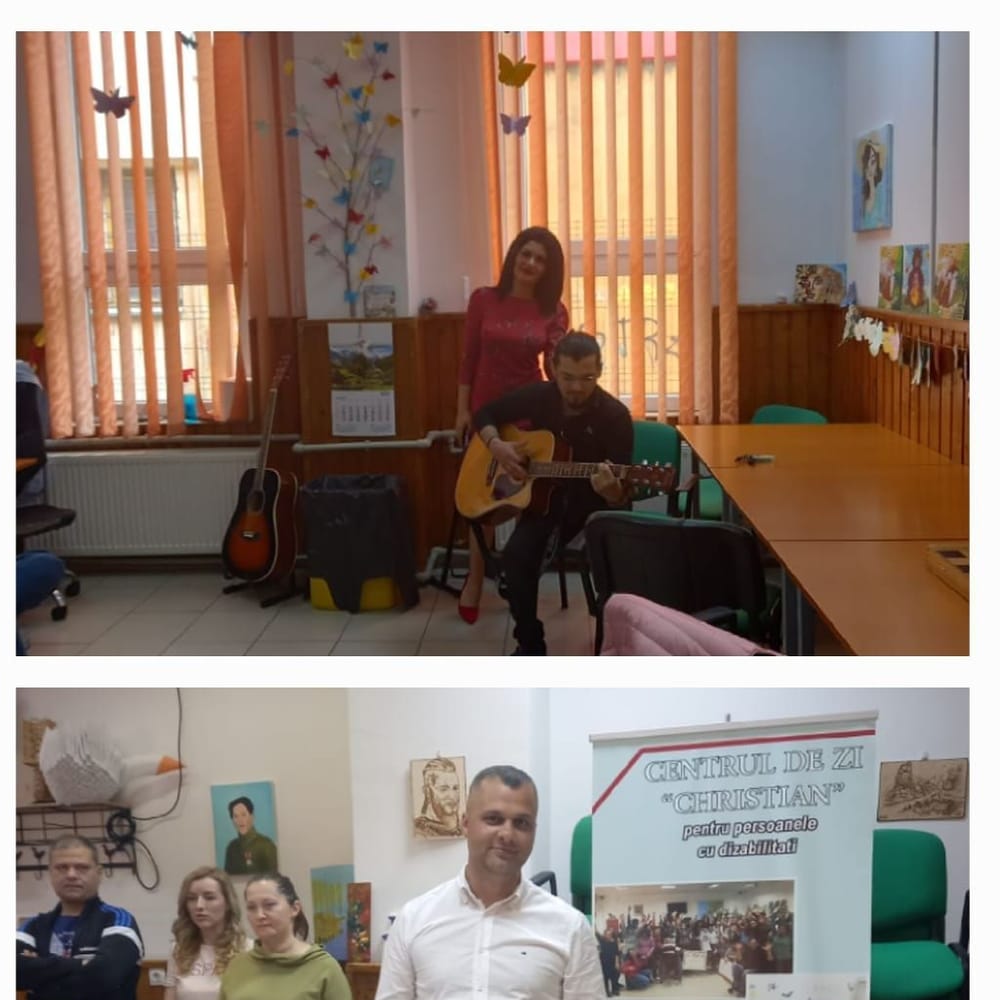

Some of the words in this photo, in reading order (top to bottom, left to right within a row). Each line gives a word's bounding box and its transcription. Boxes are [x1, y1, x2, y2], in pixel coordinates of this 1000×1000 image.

[643, 751, 777, 783] CENTRUL
[784, 748, 825, 773] DE
[832, 745, 865, 771] ZI
[682, 821, 732, 840] pentru
[732, 816, 819, 838] persoanele
[696, 844, 716, 859] cu
[717, 838, 798, 858] dizabilitati
